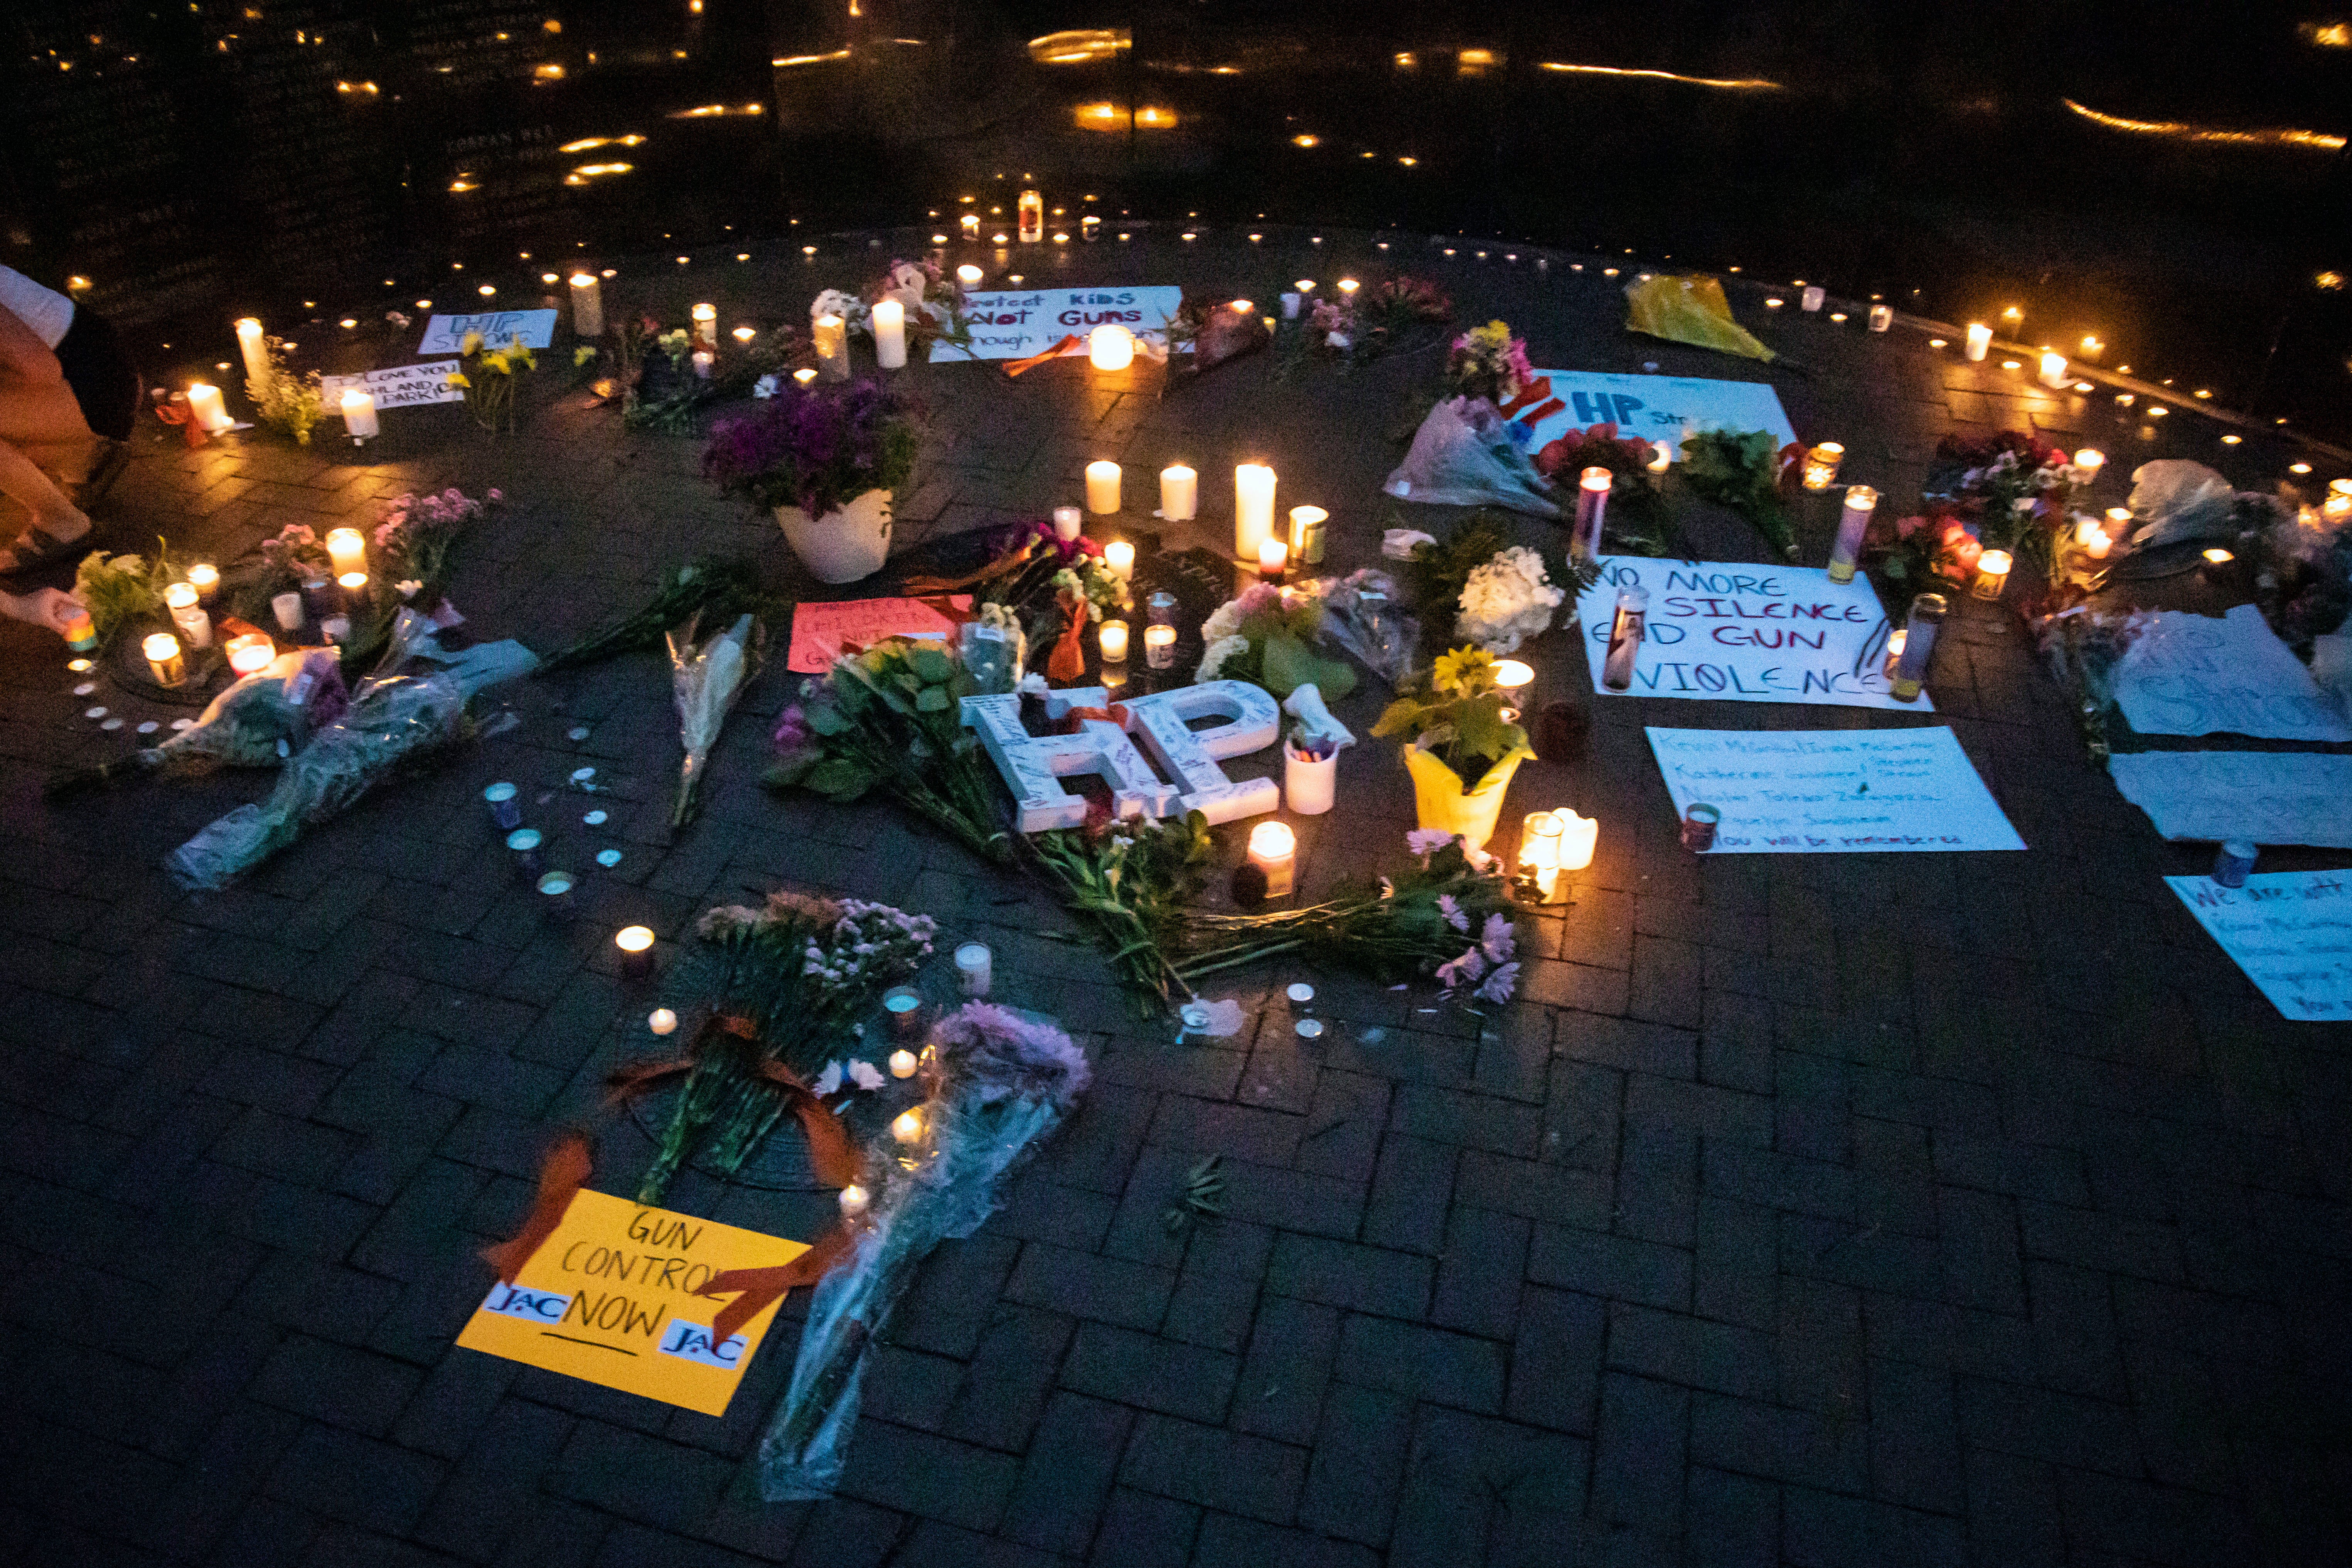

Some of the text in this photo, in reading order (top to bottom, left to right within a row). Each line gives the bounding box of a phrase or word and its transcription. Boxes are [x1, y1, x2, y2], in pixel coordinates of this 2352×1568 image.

[1668, 570, 1787, 597] MORE
[1664, 598, 1868, 623] SILENCE
[1591, 622, 1826, 649] ED GUN
[628, 1211, 703, 1251] GUN
[563, 1290, 665, 1337] NOW
